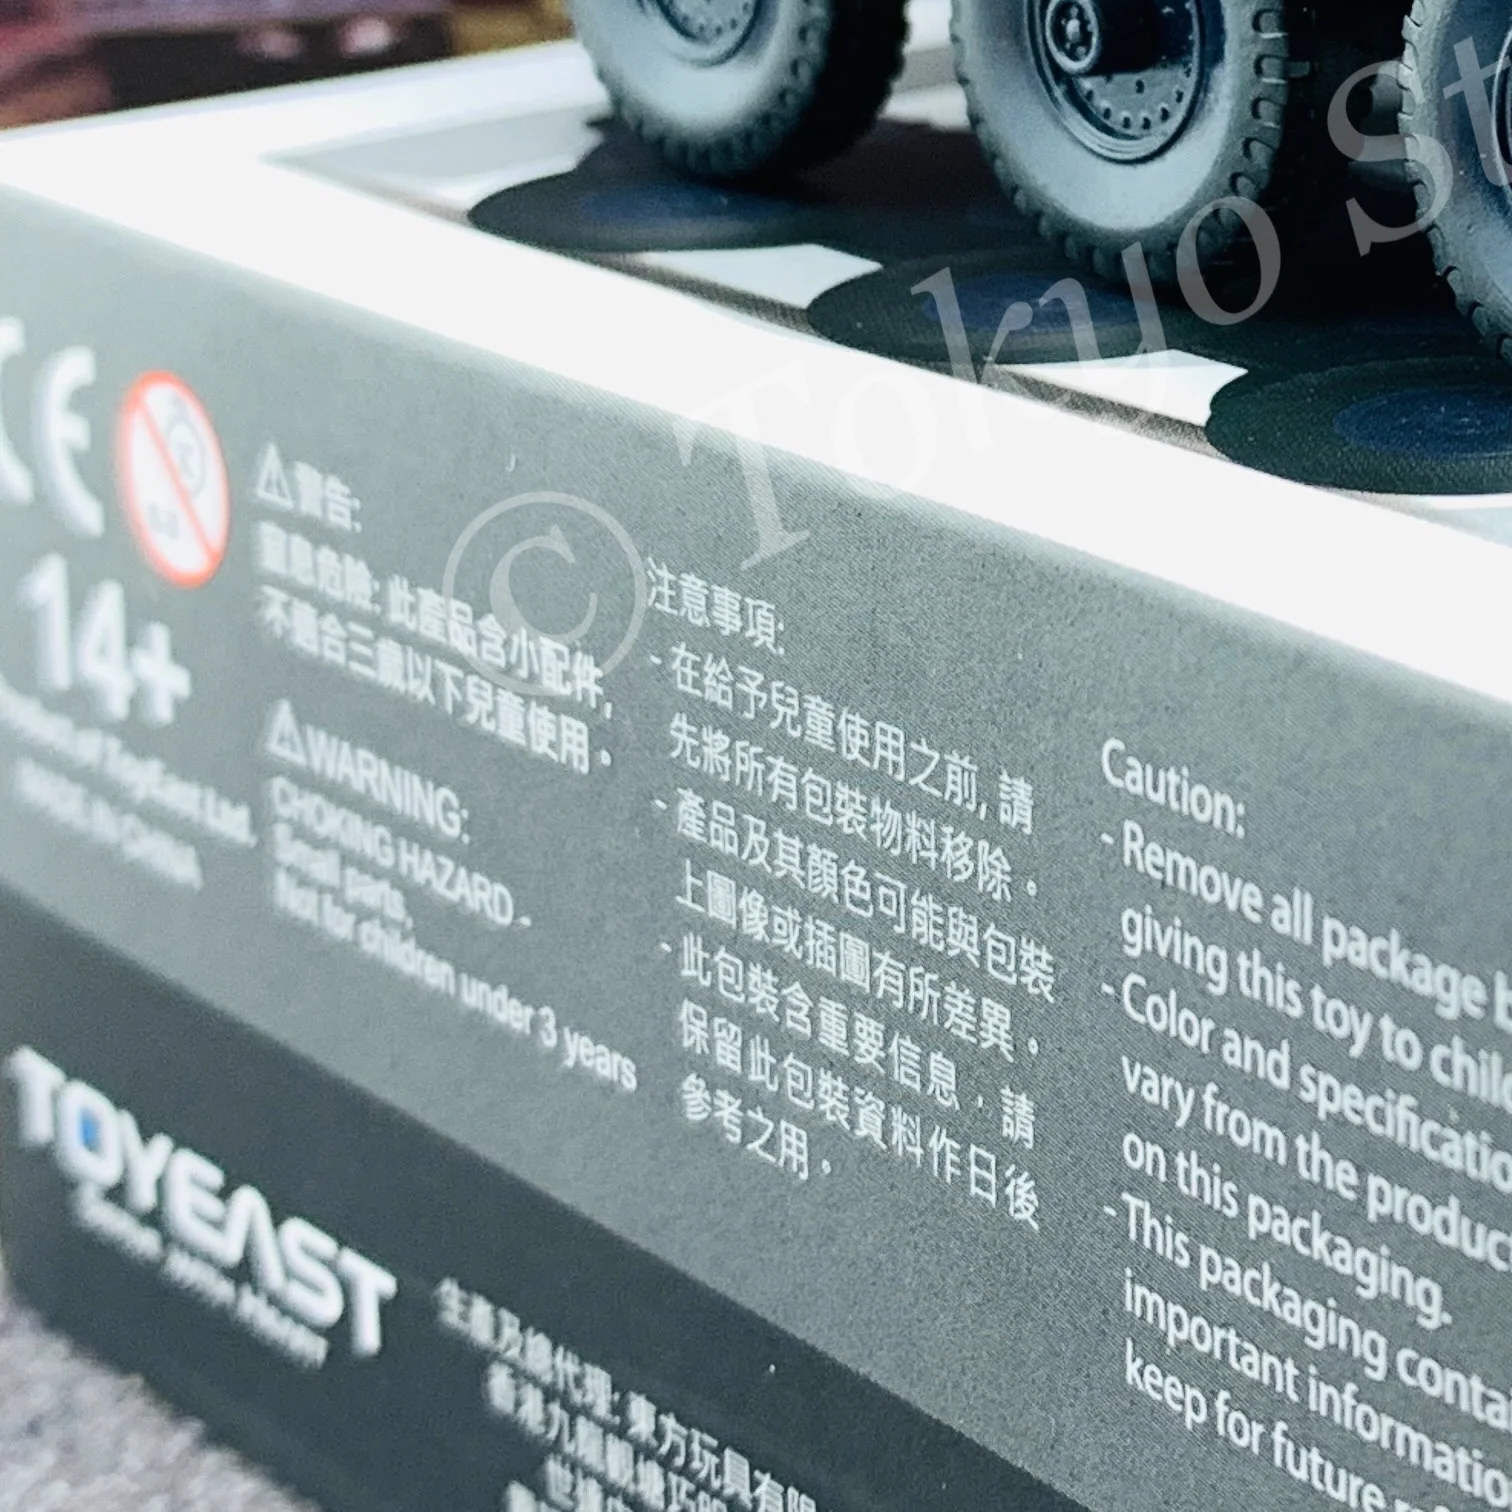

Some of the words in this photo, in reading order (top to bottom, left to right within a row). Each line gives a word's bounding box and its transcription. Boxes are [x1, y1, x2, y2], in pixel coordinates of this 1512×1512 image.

[18, 552, 191, 725] 14+
[647, 555, 785, 657] 注意事項:
[272, 775, 395, 868] CHOKING
[400, 837, 532, 928] HAZARD.
[306, 724, 470, 845] WARNING:
[669, 711, 1037, 903] 先將所有包裝物料移除。
[1101, 738, 1246, 838] Caution:
[675, 858, 1039, 1063] 上圖像或插圖有所差異。
[677, 787, 1055, 1004] 產品及其顏色可能與包裝
[1122, 819, 1263, 924] Remove
[1271, 888, 1313, 945] all
[1322, 912, 1487, 1021] package
[359, 916, 456, 996] children
[460, 971, 535, 1035] under
[537, 1005, 558, 1048] 3
[563, 1025, 638, 1093] years
[1121, 904, 1229, 994] giving
[1238, 942, 1304, 1019] this
[1311, 984, 1371, 1058] toy
[1380, 1012, 1423, 1071] to
[1122, 972, 1215, 1055] Color
[1221, 1020, 1291, 1090] and
[9, 1044, 397, 1356] TOYEAST
[679, 997, 1039, 1231] 保留此包裝資料作日後
[681, 1072, 832, 1181] 參考之用。
[1121, 1054, 1195, 1128] vary
[1201, 1082, 1288, 1165] from
[1295, 1131, 1359, 1200] the
[1120, 1191, 1191, 1268] This
[1199, 1238, 1387, 1382] packaging
[1122, 1131, 1167, 1183] on
[1175, 1149, 1238, 1217] this
[1247, 1191, 1453, 1329] packaging.
[1122, 1267, 1300, 1402] important
[1124, 1337, 1208, 1429] keep
[1215, 1390, 1268, 1456] for
[1270, 1420, 1386, 1512] future
